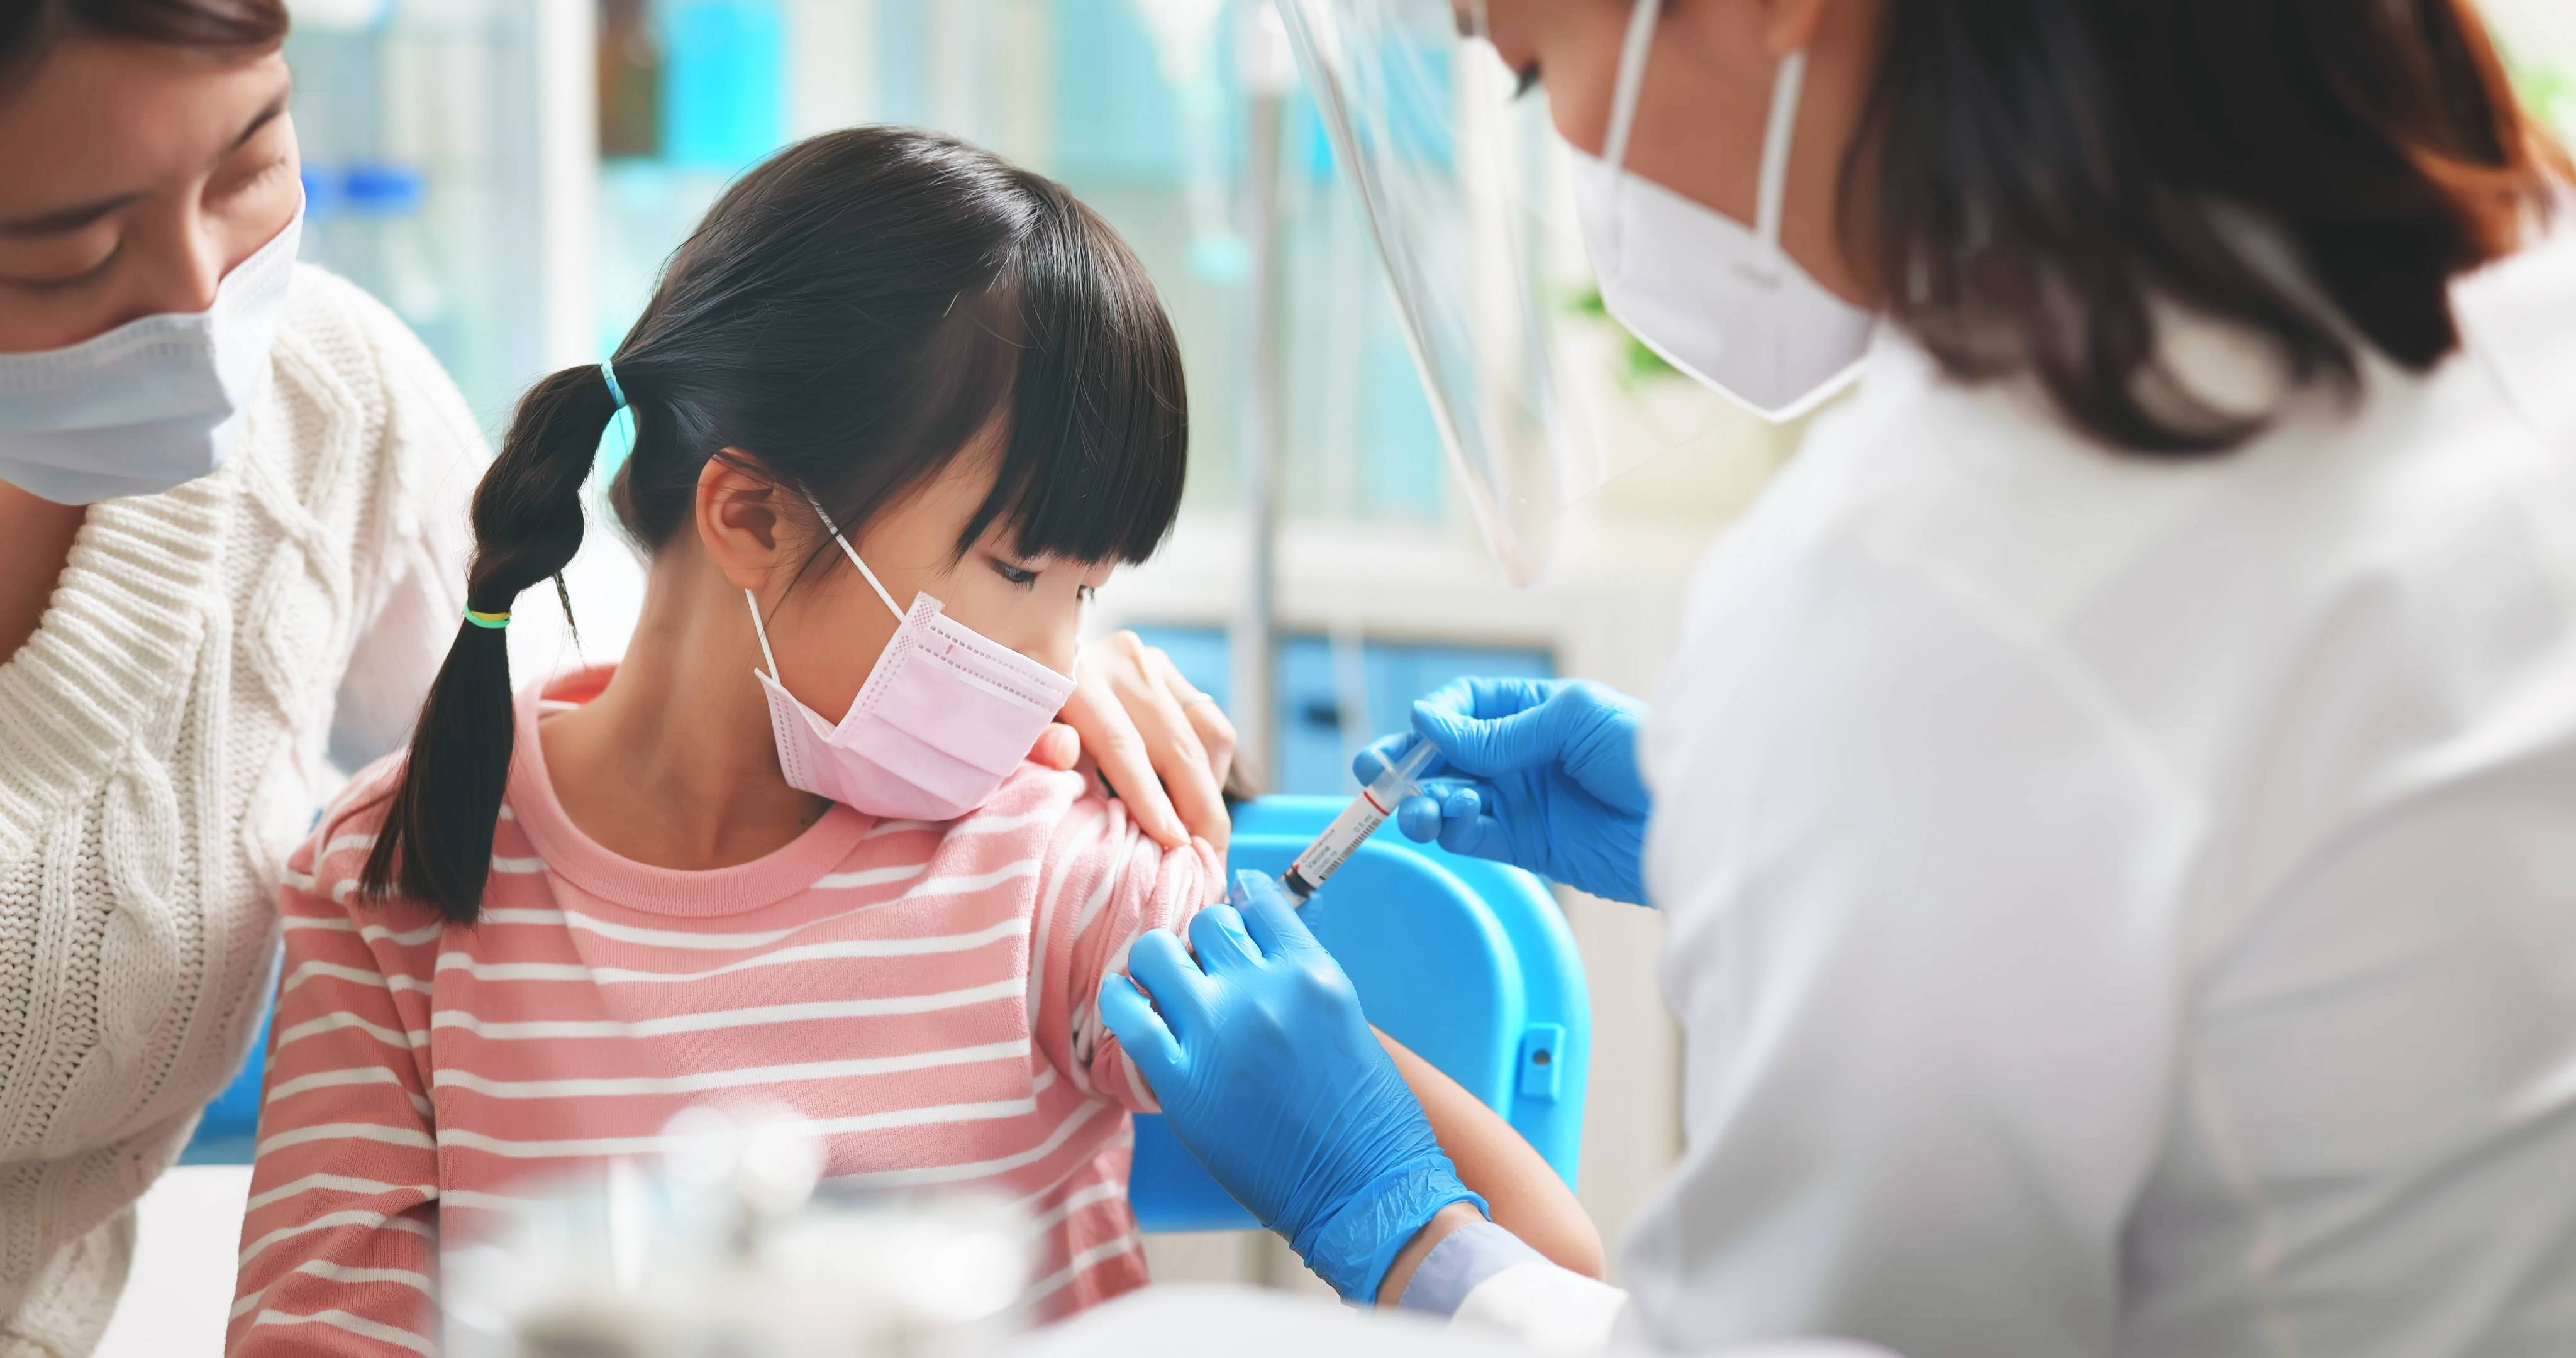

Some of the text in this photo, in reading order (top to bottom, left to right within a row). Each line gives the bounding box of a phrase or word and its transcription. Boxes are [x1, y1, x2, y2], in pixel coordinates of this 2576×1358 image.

[1364, 814, 1374, 824] ml
[1306, 846, 1331, 869] Vaccine
[1313, 851, 1338, 875] COVID-19
